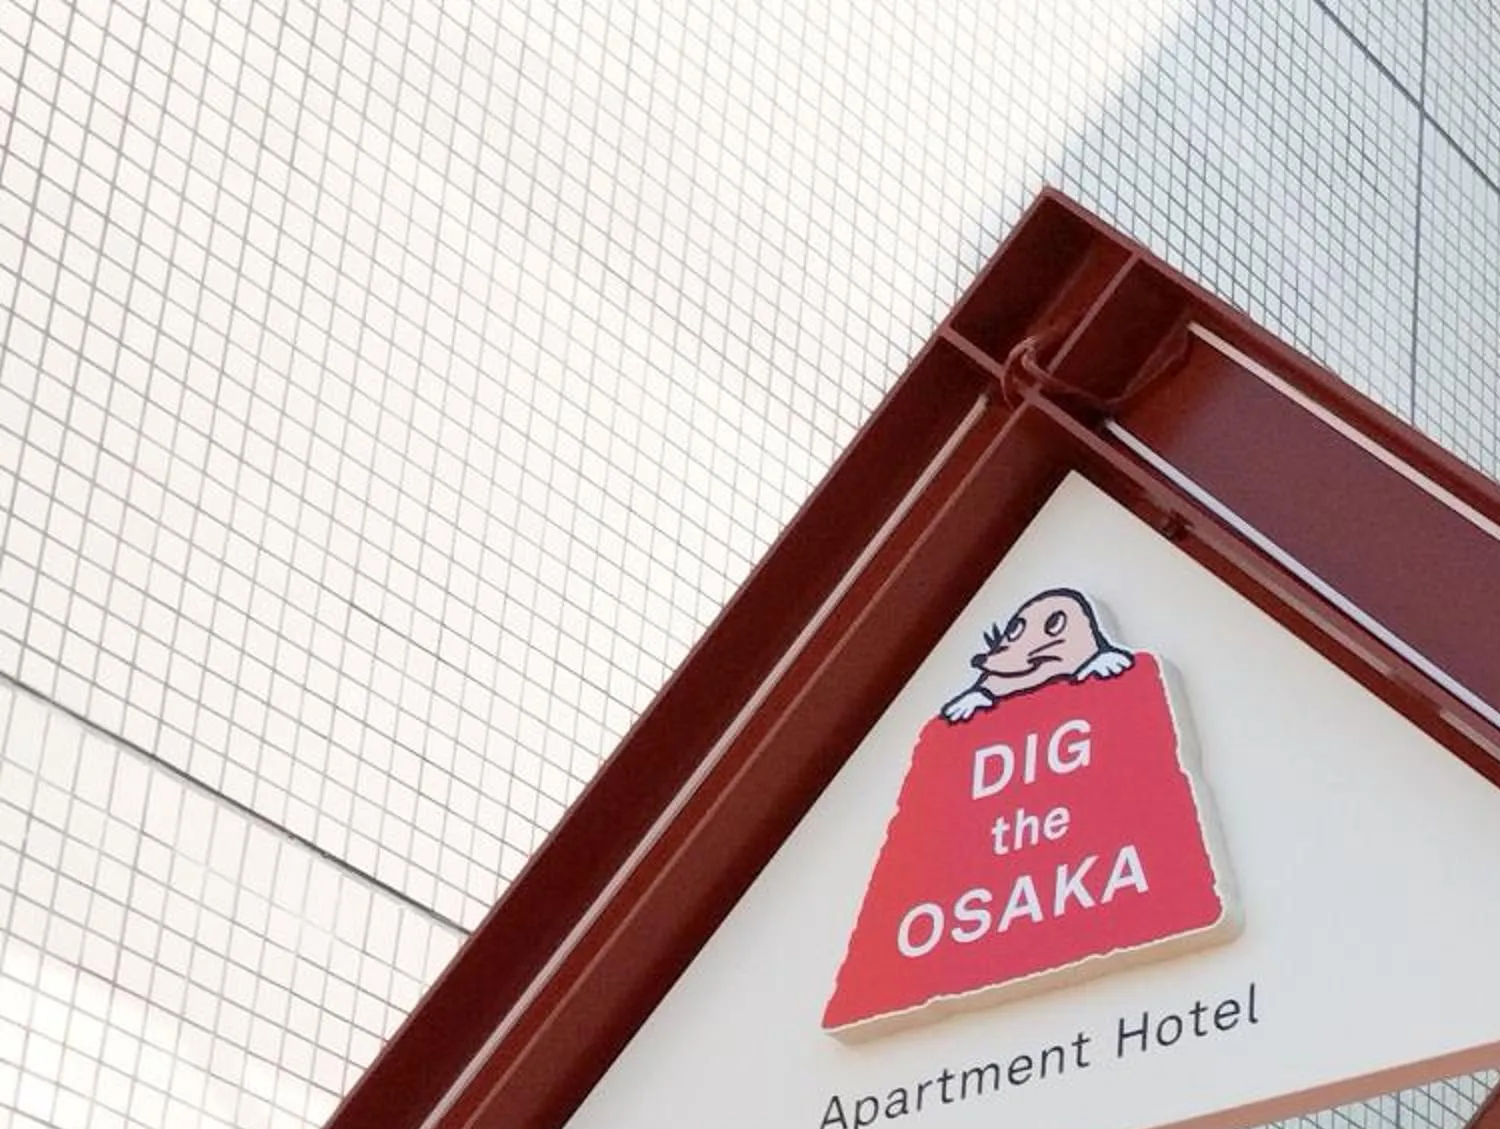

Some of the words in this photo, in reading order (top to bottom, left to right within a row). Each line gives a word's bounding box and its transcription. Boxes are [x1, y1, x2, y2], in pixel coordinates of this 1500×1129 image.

[971, 718, 1092, 800] DIG
[991, 806, 1070, 856] the
[897, 844, 1150, 958] OSAKA
[1116, 983, 1260, 1058] Hotel
